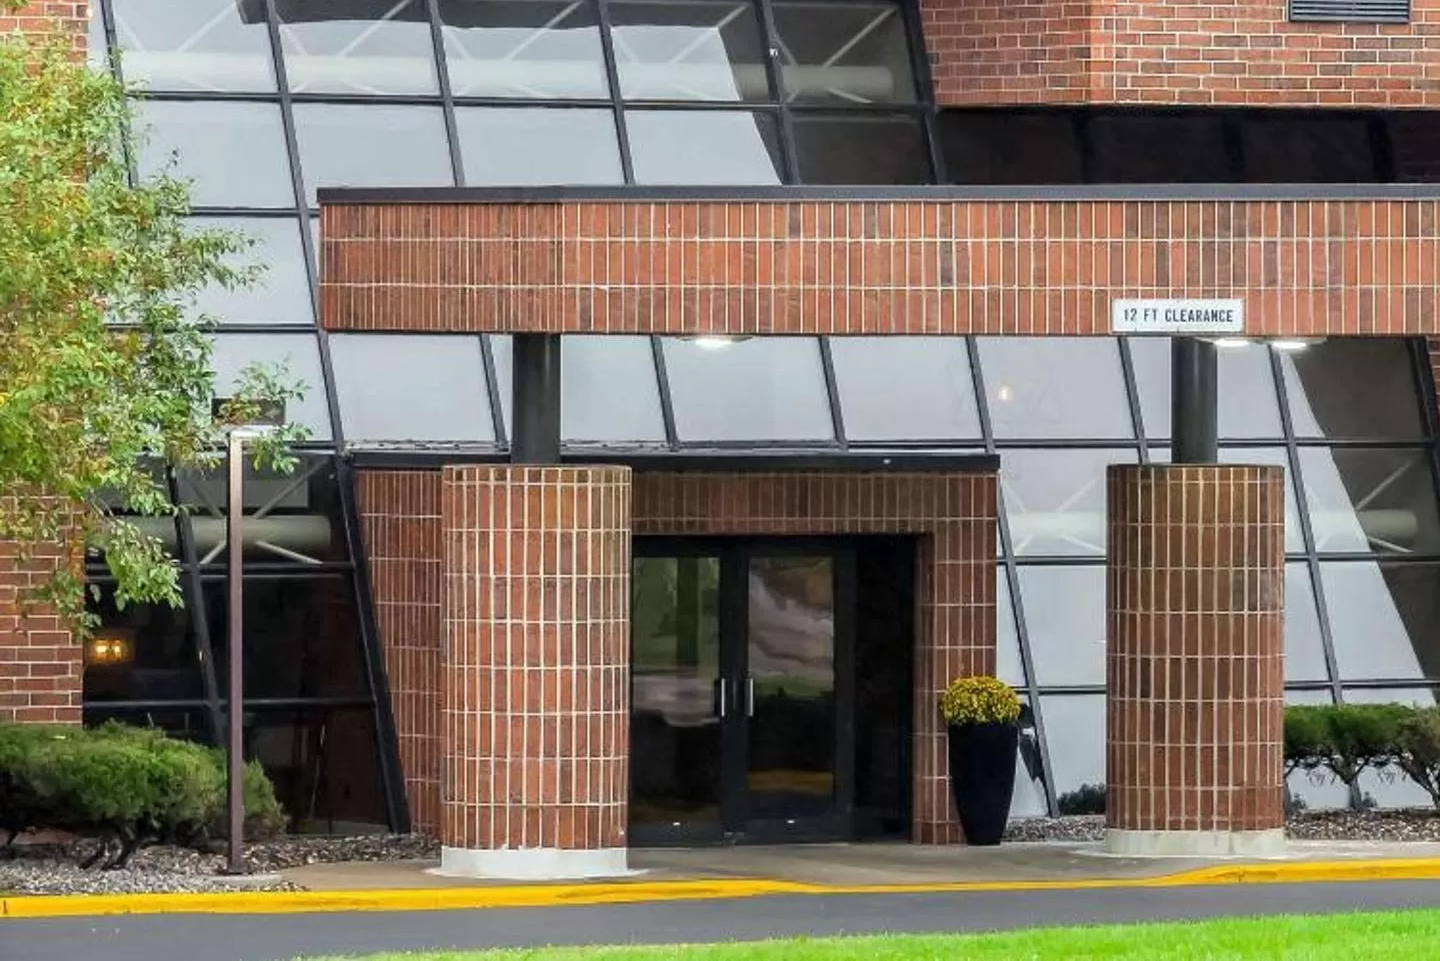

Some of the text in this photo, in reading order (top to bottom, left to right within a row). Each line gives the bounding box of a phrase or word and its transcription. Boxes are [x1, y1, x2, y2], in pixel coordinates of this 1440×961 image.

[1124, 308, 1234, 323] 12 FT CLEARANCE
